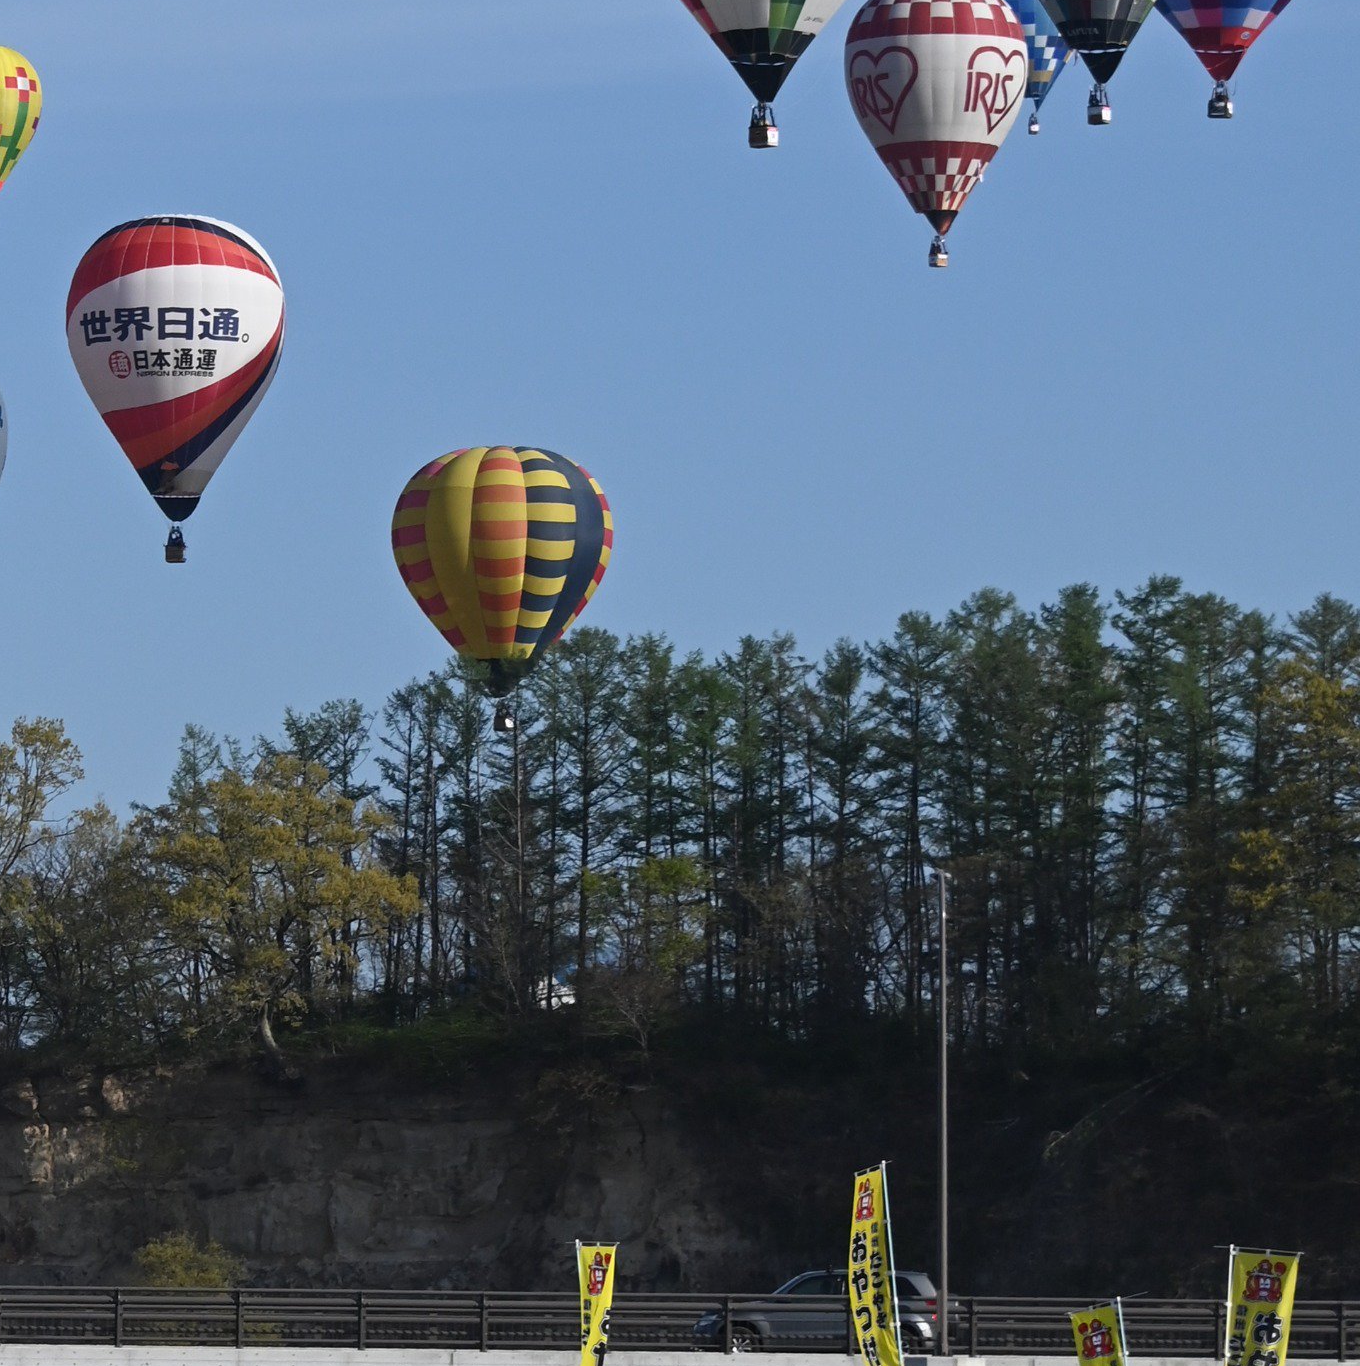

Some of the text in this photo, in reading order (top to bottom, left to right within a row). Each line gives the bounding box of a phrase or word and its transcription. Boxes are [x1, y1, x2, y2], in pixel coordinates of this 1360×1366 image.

[963, 71, 1014, 115] IRIS
[78, 305, 250, 346] 世界日通。
[133, 348, 218, 371] 日本通運
[136, 370, 215, 378] NIPPON EXPRESS
